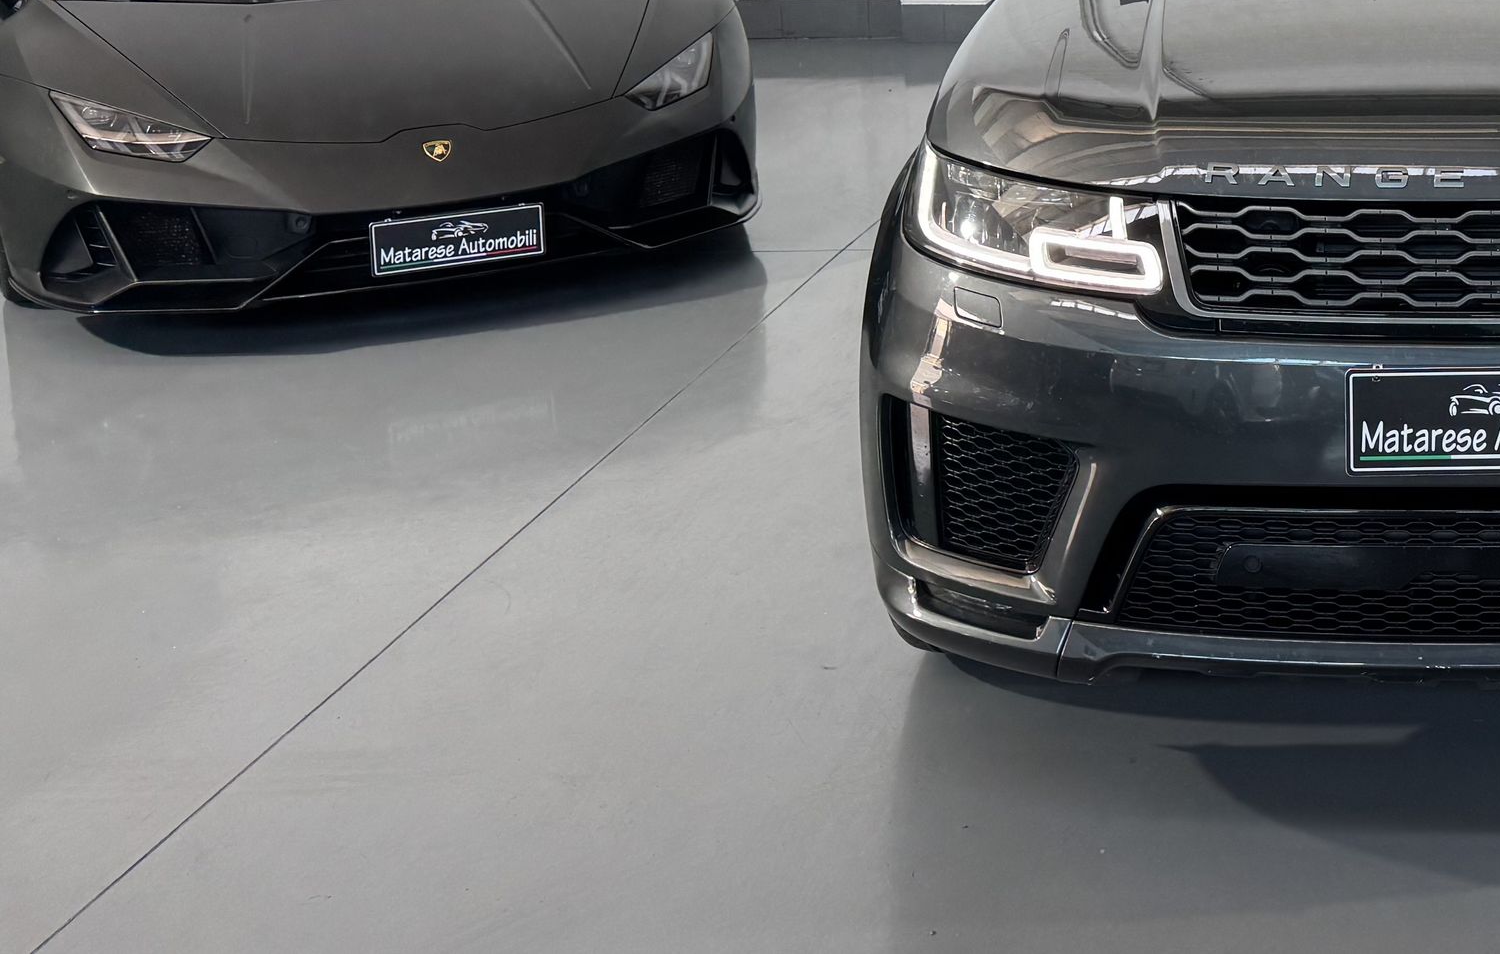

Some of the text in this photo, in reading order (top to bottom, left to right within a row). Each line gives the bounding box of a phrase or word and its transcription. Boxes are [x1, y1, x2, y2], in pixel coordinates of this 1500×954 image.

[1204, 161, 1465, 188] RANGE
[380, 229, 537, 266] Matarese Automobili
[1361, 420, 1487, 453] Matarese
